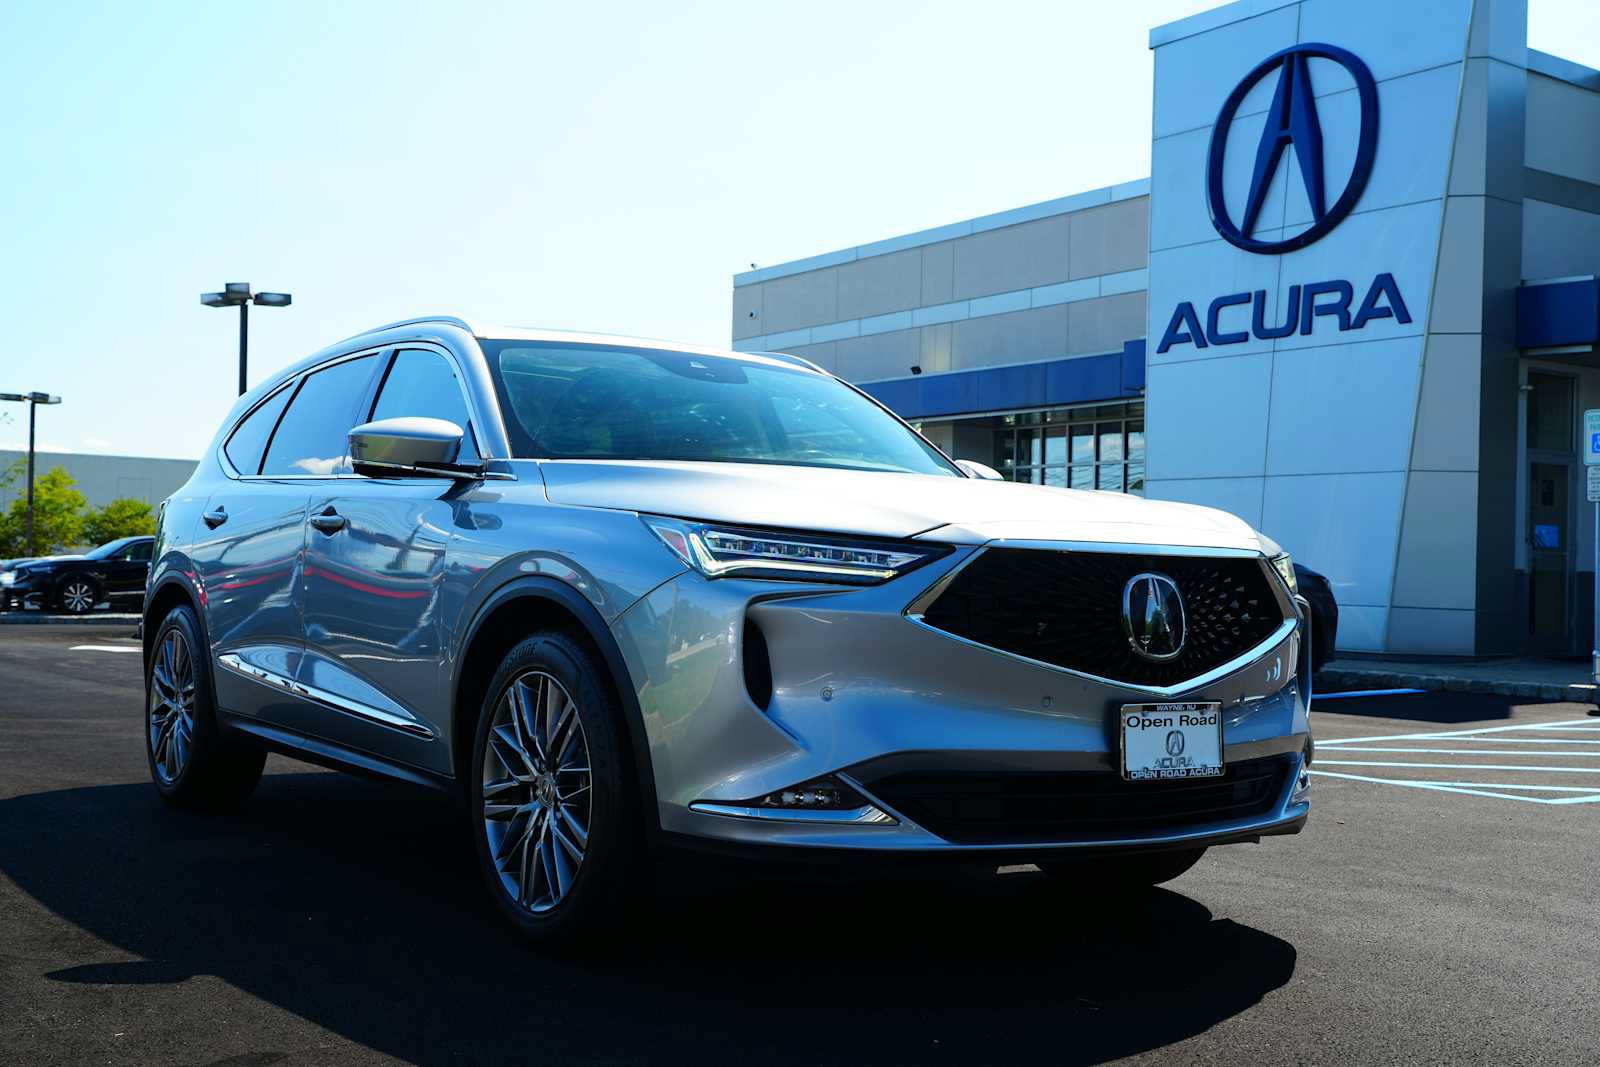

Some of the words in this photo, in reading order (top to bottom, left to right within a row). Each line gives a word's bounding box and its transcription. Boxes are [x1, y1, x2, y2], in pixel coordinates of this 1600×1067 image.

[1156, 272, 1412, 353] ACURA
[1127, 716, 1173, 730] Open
[1179, 714, 1217, 727] Road
[1154, 757, 1195, 769] ACURA
[1131, 770, 1158, 779] OPEN
[1160, 769, 1187, 778] ROAD
[1190, 767, 1220, 776] ACURA
